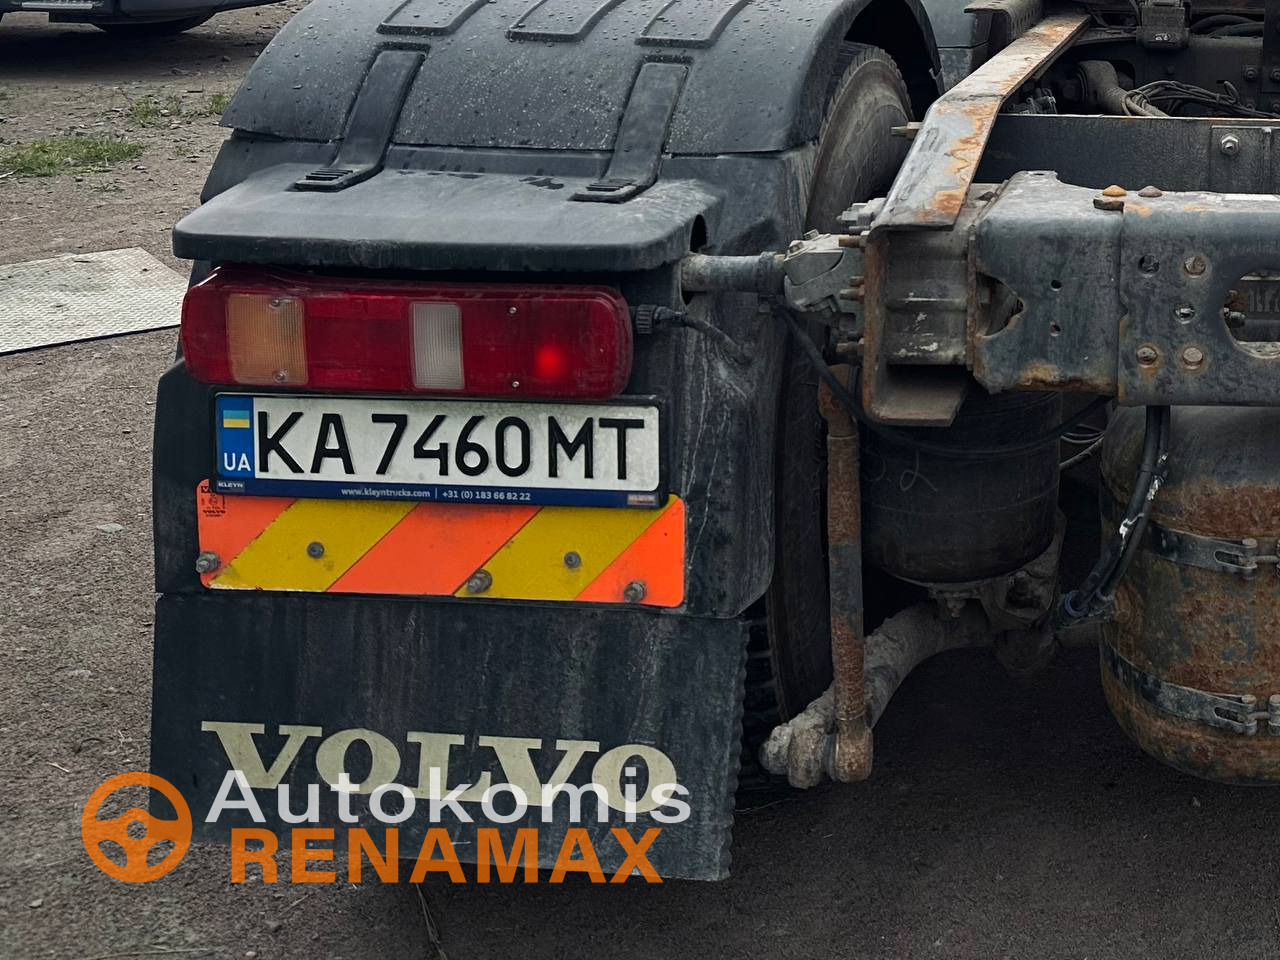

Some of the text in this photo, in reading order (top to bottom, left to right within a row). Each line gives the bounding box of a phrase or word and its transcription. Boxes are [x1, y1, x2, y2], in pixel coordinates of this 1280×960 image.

[223, 451, 252, 471] UA
[257, 411, 645, 481] KA 7460 MT
[475, 491, 492, 500] 183
[506, 492, 518, 500] 82
[519, 492, 531, 501] 22
[201, 721, 678, 813] VOLVO
